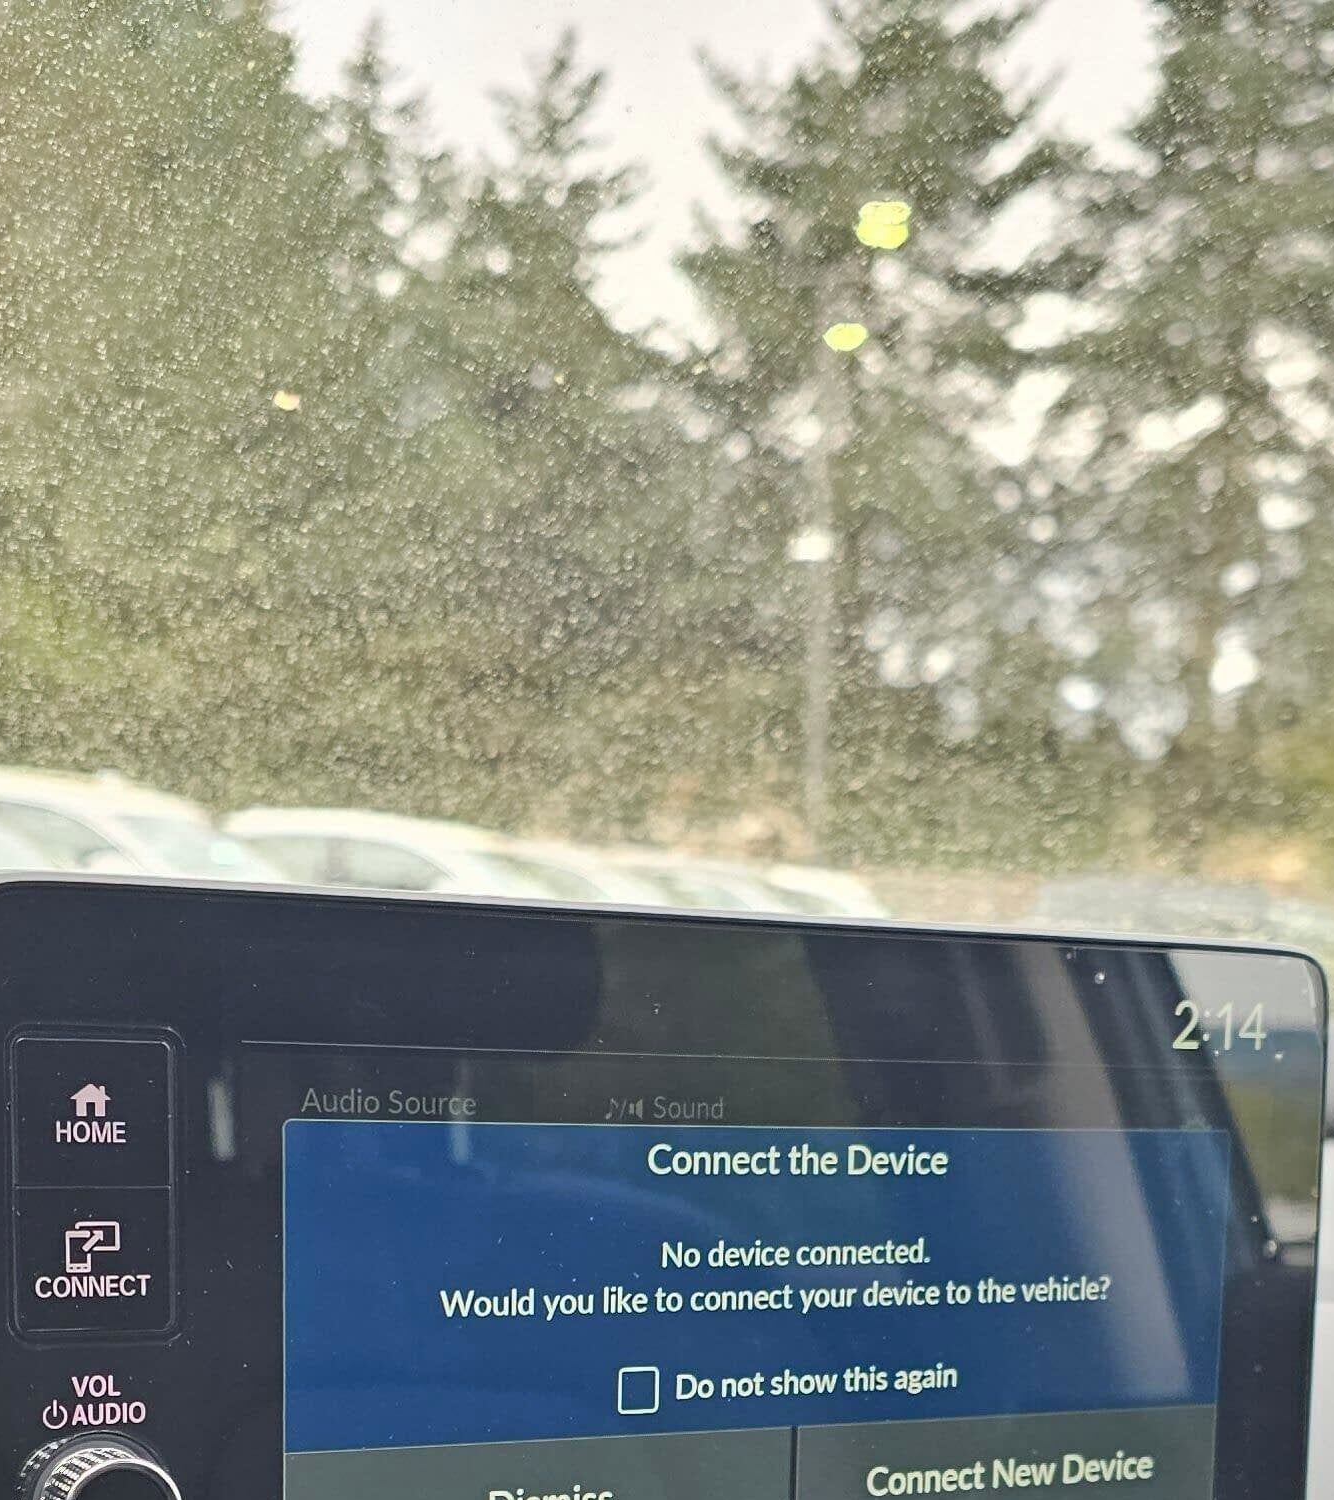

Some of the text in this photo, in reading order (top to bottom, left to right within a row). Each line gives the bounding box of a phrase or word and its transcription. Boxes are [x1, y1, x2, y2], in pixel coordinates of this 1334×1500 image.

[1172, 1000, 1267, 1050] 2:14
[300, 1088, 477, 1116] Audio Source
[652, 1096, 724, 1120] Sound
[55, 1121, 127, 1144] HOME
[647, 1143, 949, 1176] Connect the Device
[660, 1237, 931, 1268] No device connected.
[34, 1274, 151, 1299] CONNECT
[439, 1276, 1111, 1321] Would you like to connect your device to the vehicle?
[71, 1374, 121, 1398] VOL
[675, 1362, 958, 1400] Do not show this again
[71, 1401, 146, 1426] AUDIO
[866, 1451, 1155, 1497] Connect New Device
